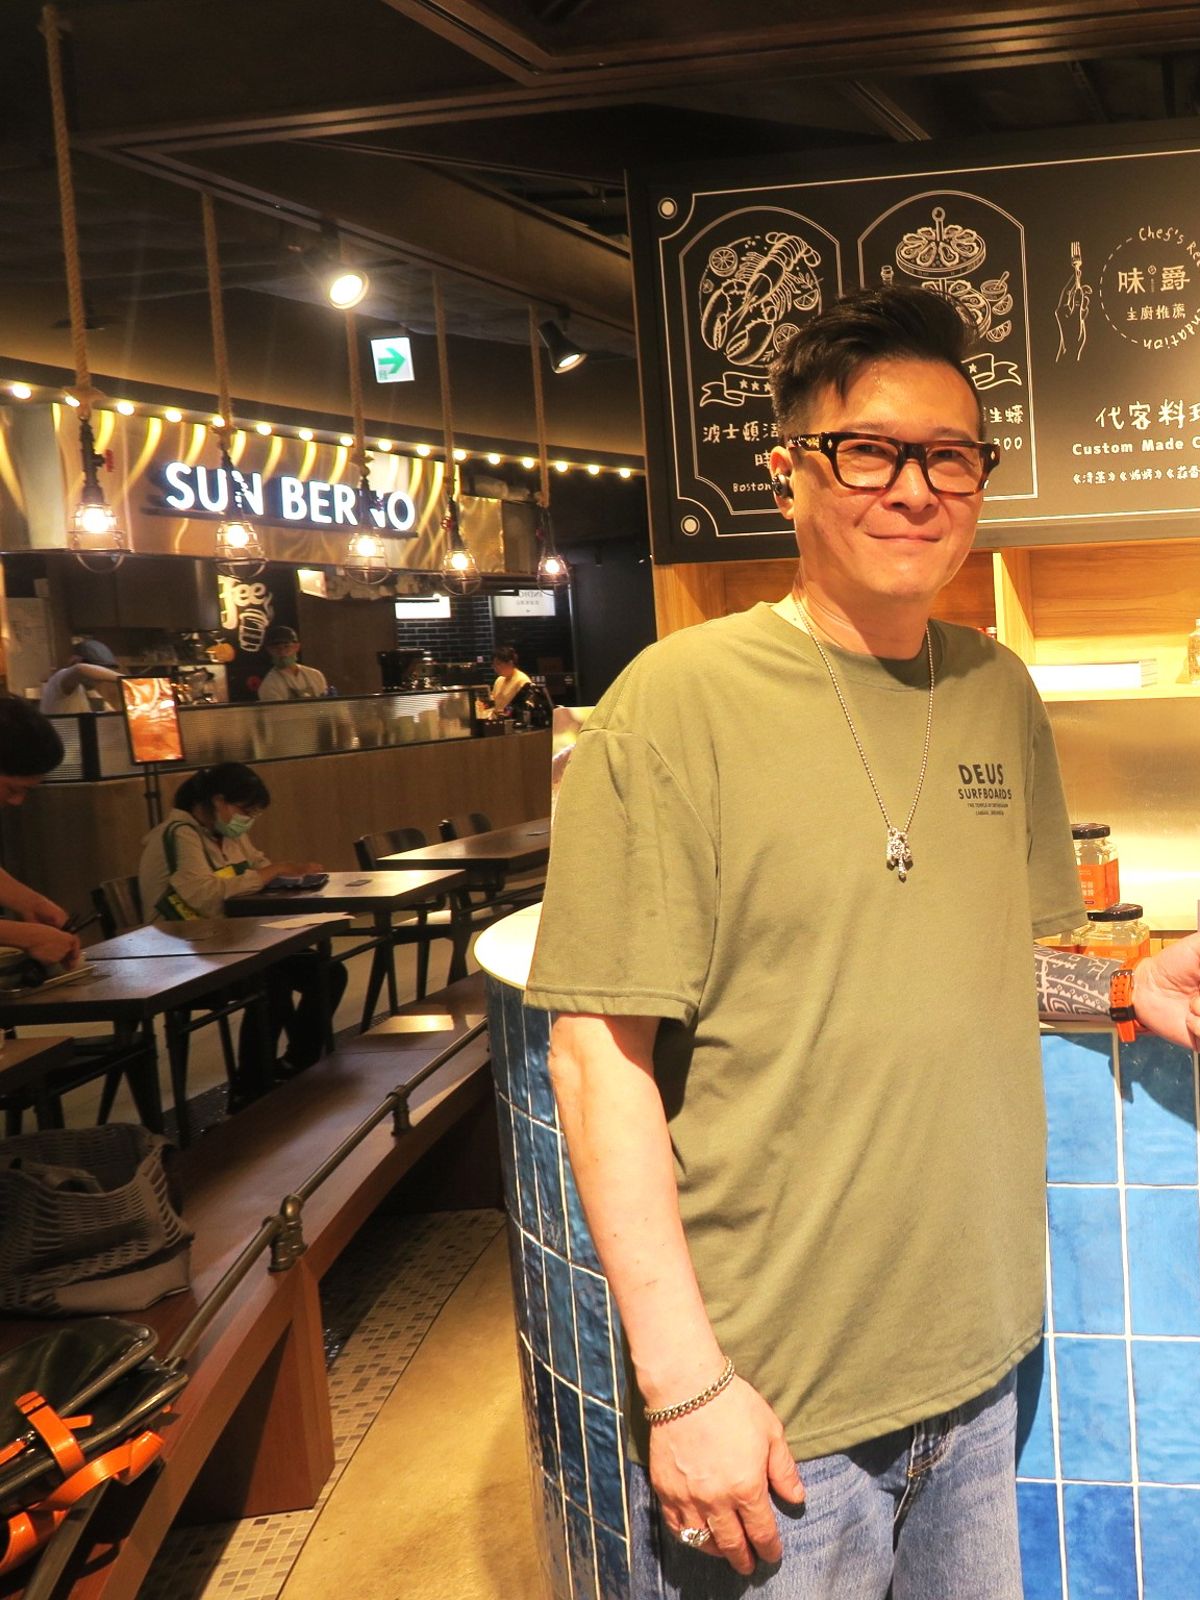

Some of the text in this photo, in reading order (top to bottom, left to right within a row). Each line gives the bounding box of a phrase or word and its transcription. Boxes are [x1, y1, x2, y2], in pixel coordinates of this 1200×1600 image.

[1139, 225, 1185, 245] Chef's
[1126, 303, 1186, 321] 主廚推薦
[983, 404, 1024, 425] 生蠔
[1072, 440, 1133, 456] Custom
[1141, 435, 1184, 451] Made
[165, 462, 265, 516] SUN
[733, 481, 772, 493] Boston
[958, 763, 1004, 785] DEUS
[958, 788, 1012, 800] SURFBOARDS
